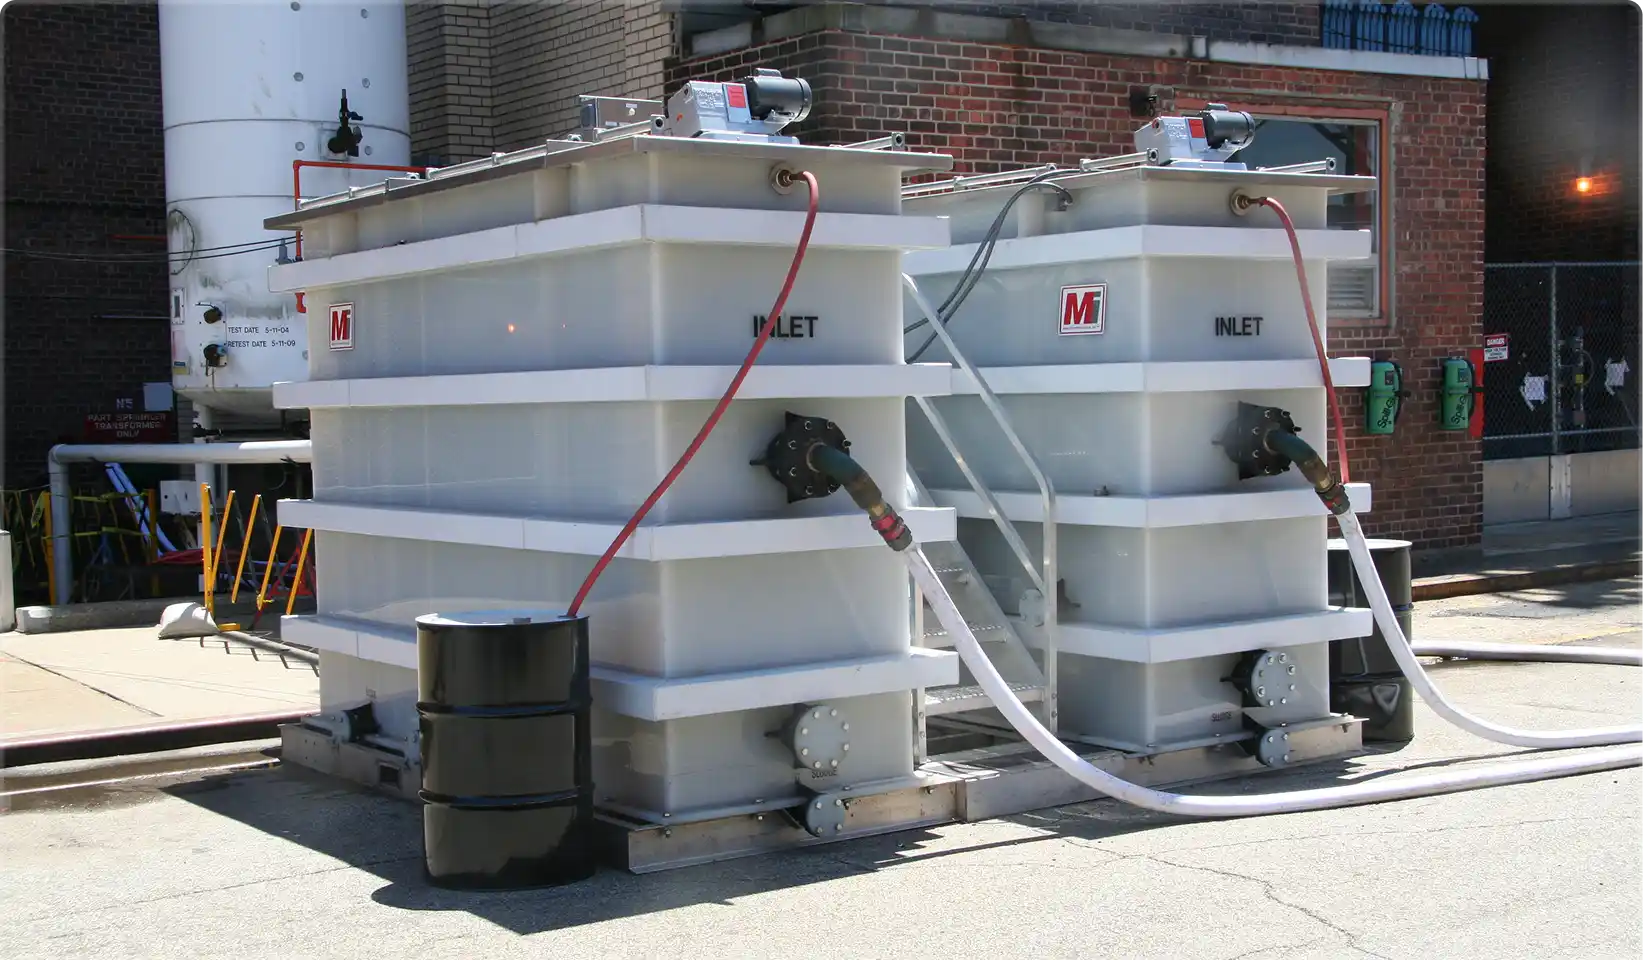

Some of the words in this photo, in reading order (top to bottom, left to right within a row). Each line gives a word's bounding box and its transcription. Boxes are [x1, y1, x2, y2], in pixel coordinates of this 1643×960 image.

[228, 326, 242, 334] TEST
[244, 326, 259, 334] DATE
[265, 326, 290, 334] 5-11-04
[753, 315, 819, 338] INLET
[1215, 316, 1264, 337] INLET
[228, 340, 250, 348] RETEST
[252, 340, 267, 348] DATE
[88, 413, 112, 422] PART
[116, 429, 140, 438] ONLY
